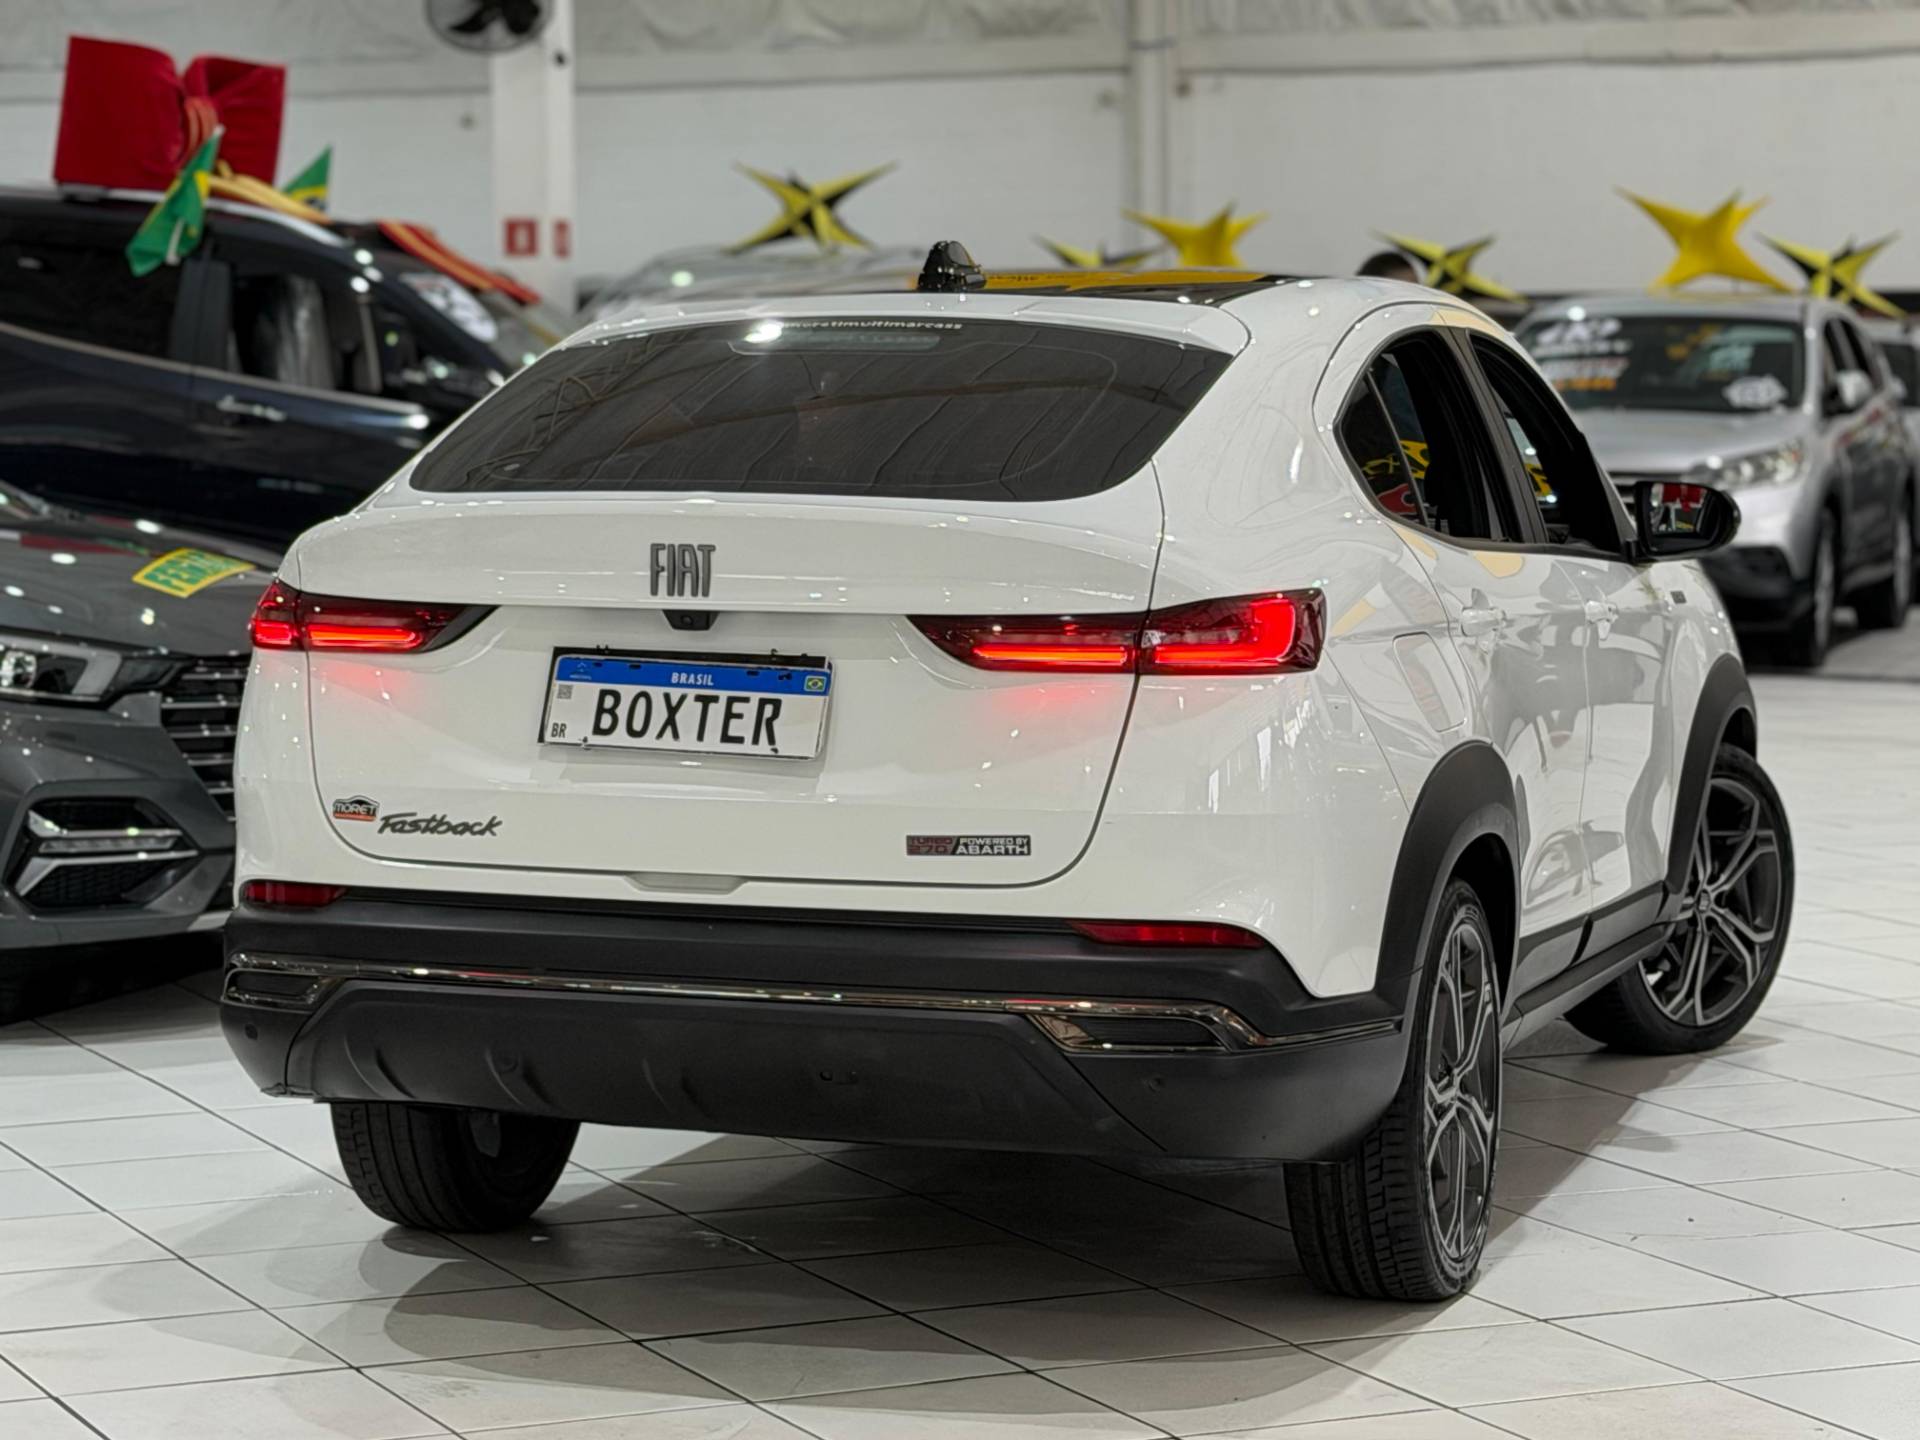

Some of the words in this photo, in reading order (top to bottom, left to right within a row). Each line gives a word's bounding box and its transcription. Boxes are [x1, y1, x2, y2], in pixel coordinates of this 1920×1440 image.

[650, 543, 716, 597] FIAT
[671, 672, 714, 686] BRASIL
[592, 689, 782, 746] BOXTER
[551, 722, 567, 738] BR
[377, 812, 503, 837] Fastback
[959, 837, 1014, 846] POWERED
[1015, 837, 1029, 846] BY
[955, 845, 1029, 855] ABARTH
